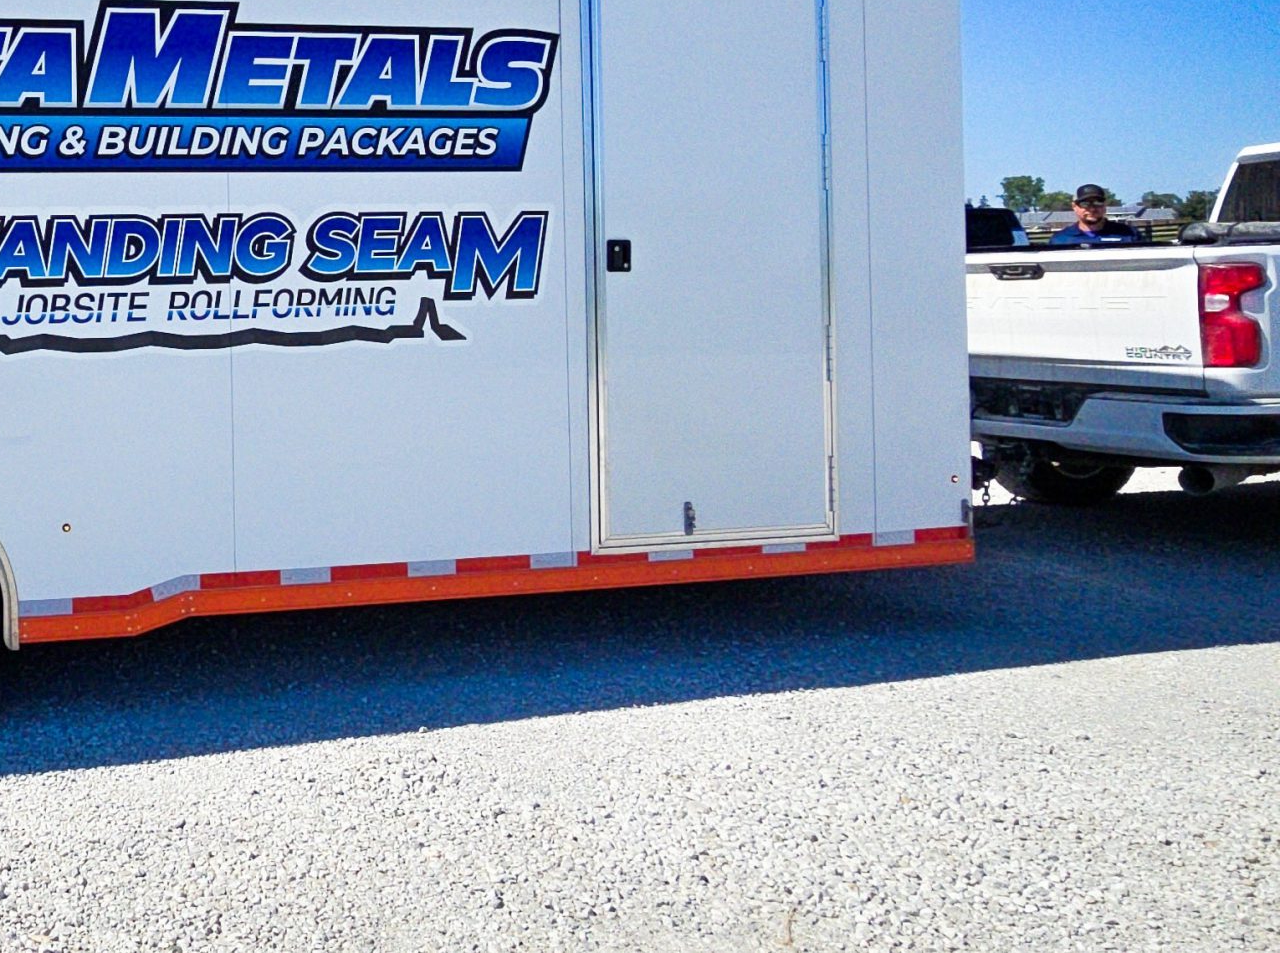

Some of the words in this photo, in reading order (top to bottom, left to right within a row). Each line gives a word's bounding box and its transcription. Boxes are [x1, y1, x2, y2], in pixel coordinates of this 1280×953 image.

[58, 124, 87, 157] &
[96, 125, 289, 157] BUILDING
[297, 127, 499, 158] PACKAGES
[299, 211, 548, 300] SEAM
[1, 291, 151, 326] JOBSITE
[166, 286, 396, 322] ROLLFORMING
[1125, 351, 1192, 361] COUNTRY
